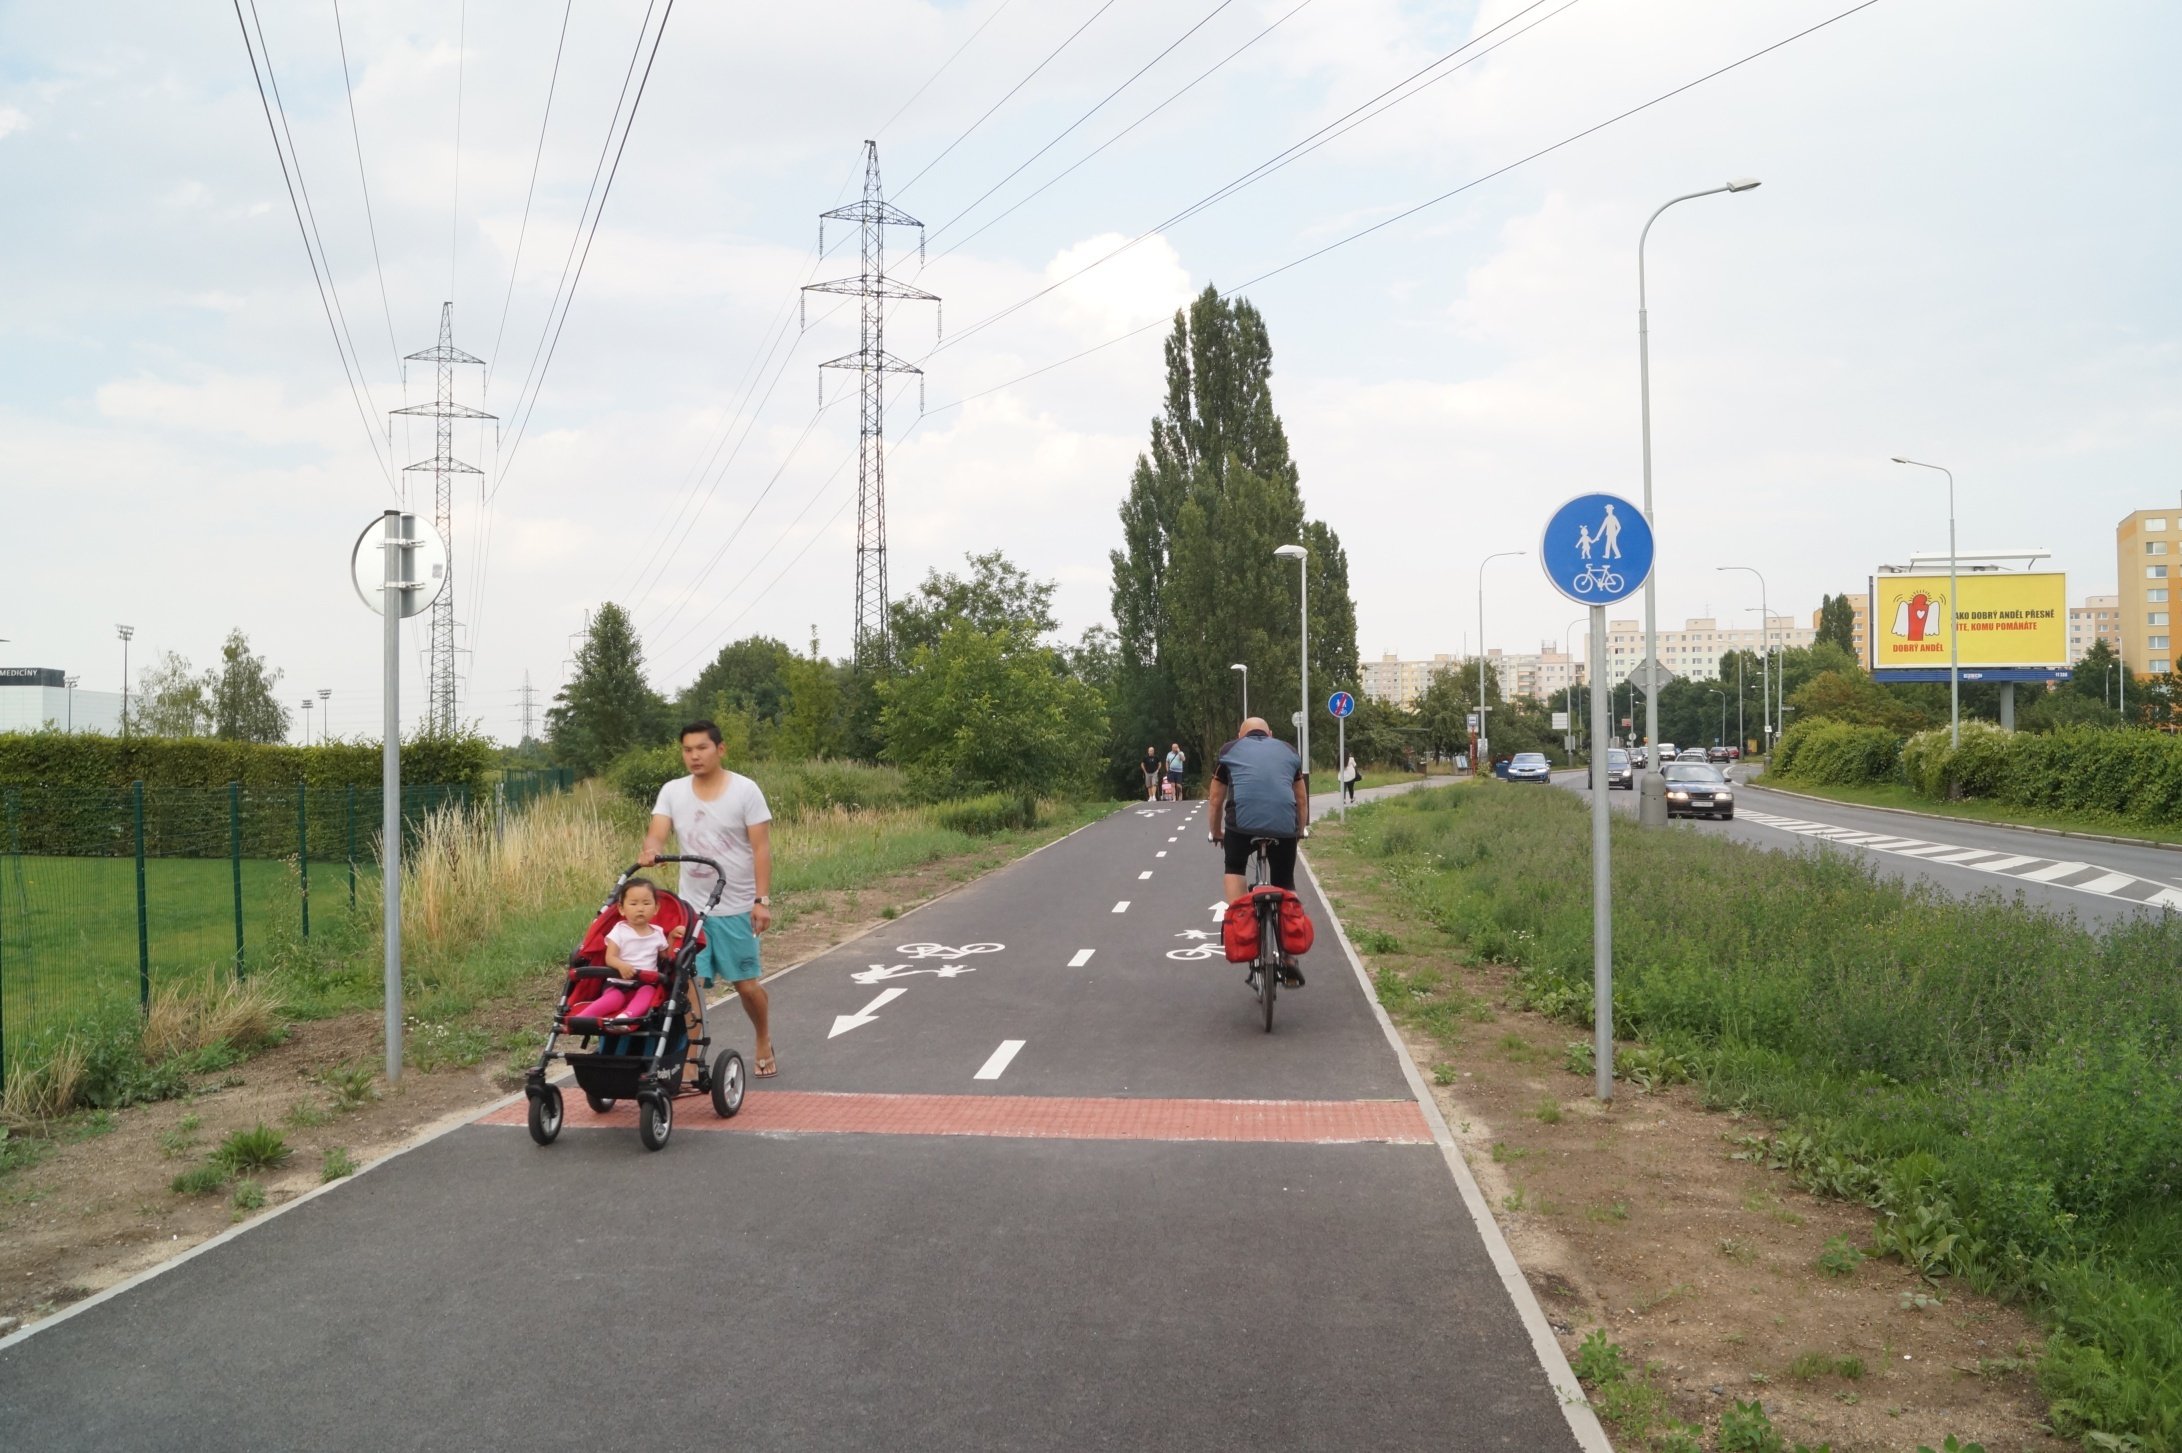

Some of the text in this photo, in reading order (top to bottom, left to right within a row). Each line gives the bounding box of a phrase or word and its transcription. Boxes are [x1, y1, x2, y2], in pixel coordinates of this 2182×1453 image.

[1955, 608, 2055, 620] AKO DOBRÝ ANDĚL PŘESNĚ
[1971, 622, 1994, 631] KOMU
[1996, 621, 2037, 631] POMÁHÁTE
[1892, 643, 1944, 652] DOBRÝ ANDĚL
[0, 668, 38, 677] MEDICÍNY
